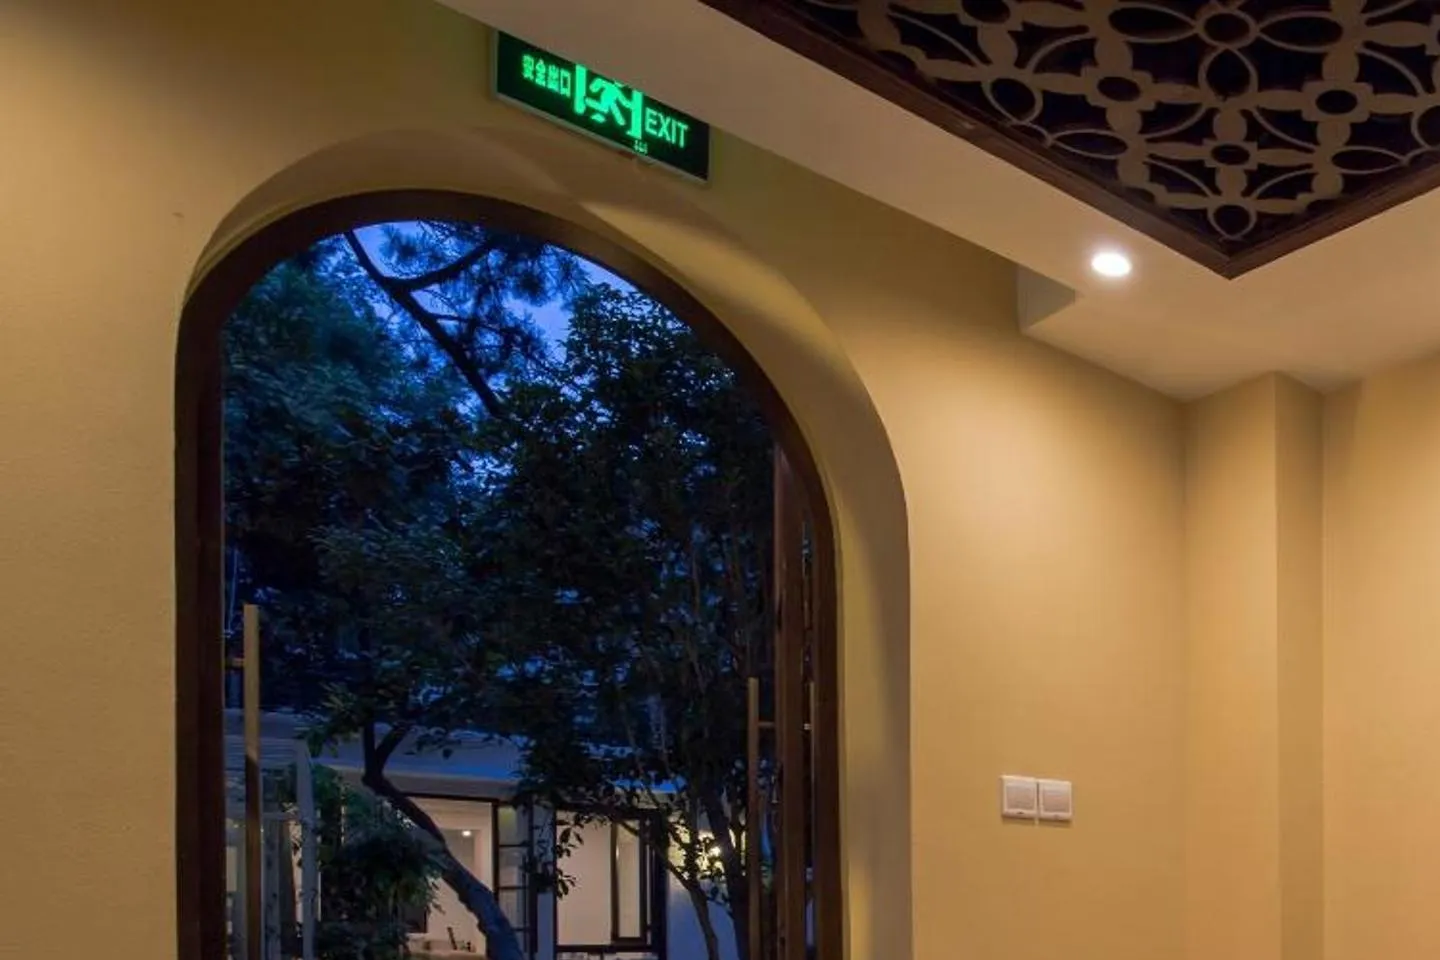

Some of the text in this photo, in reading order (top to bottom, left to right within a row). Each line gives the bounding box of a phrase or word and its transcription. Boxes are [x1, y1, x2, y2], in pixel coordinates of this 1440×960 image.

[522, 54, 571, 97] 安全出口
[645, 107, 688, 148] EXIT
